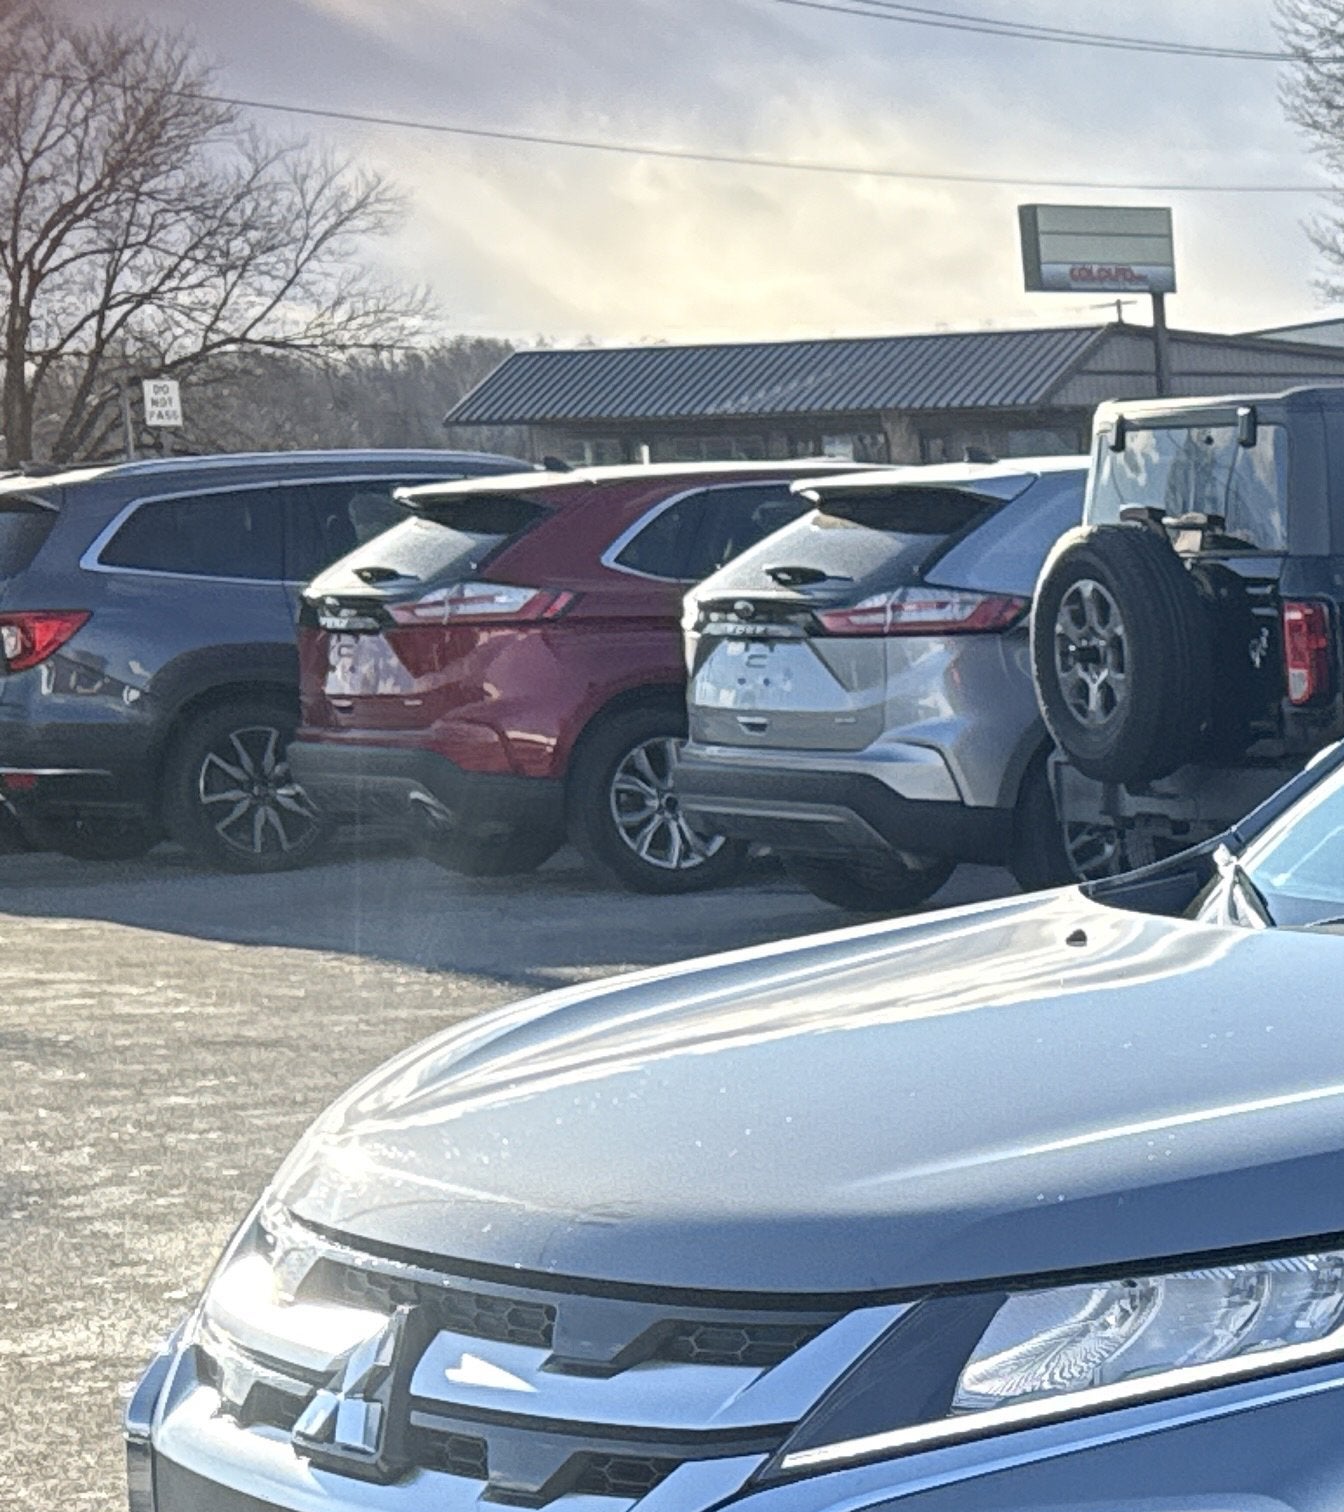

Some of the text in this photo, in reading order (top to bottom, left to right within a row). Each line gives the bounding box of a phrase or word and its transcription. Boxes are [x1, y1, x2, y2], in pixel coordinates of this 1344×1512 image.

[152, 384, 170, 395] DO
[150, 397, 173, 408] NOT
[149, 410, 180, 421] PASS
